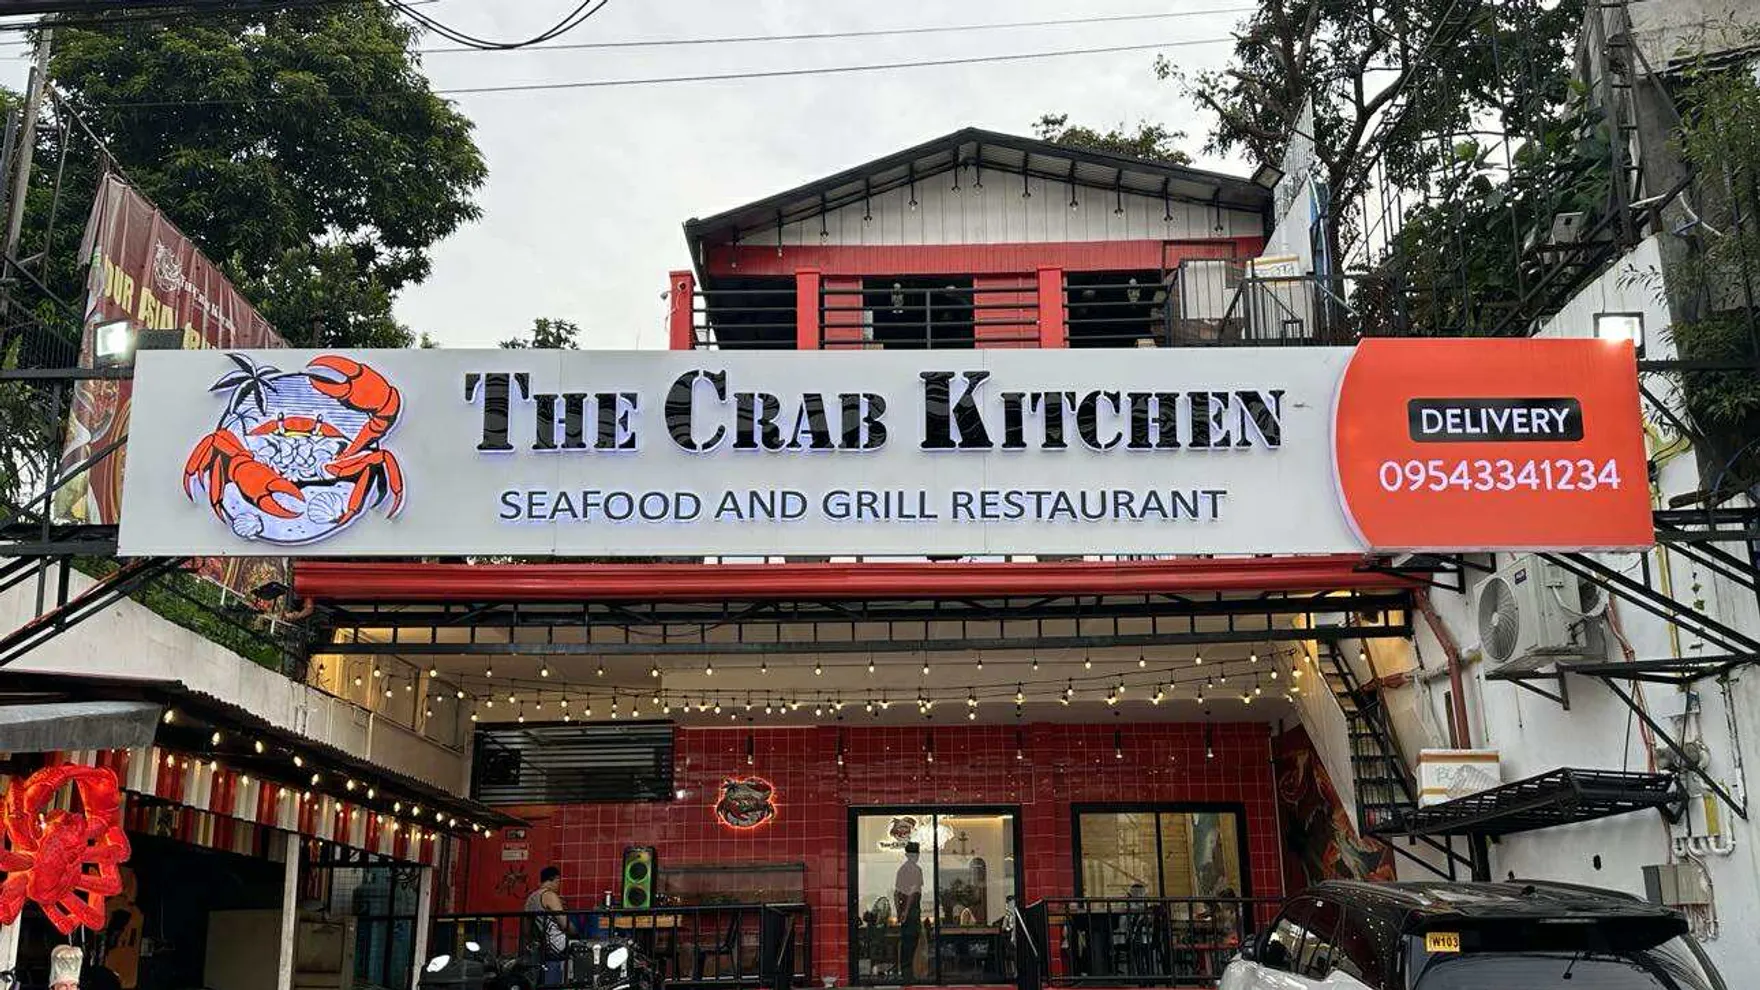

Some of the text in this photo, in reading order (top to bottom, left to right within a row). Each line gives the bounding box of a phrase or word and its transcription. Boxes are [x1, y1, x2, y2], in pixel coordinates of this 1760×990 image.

[465, 369, 1286, 453] THE CRAB KITCHEN
[1421, 408, 1570, 434] DELIVERY
[1379, 458, 1621, 492] 09543341234
[500, 489, 1227, 521] SEAFOOD AND GRILL RESTAURANT
